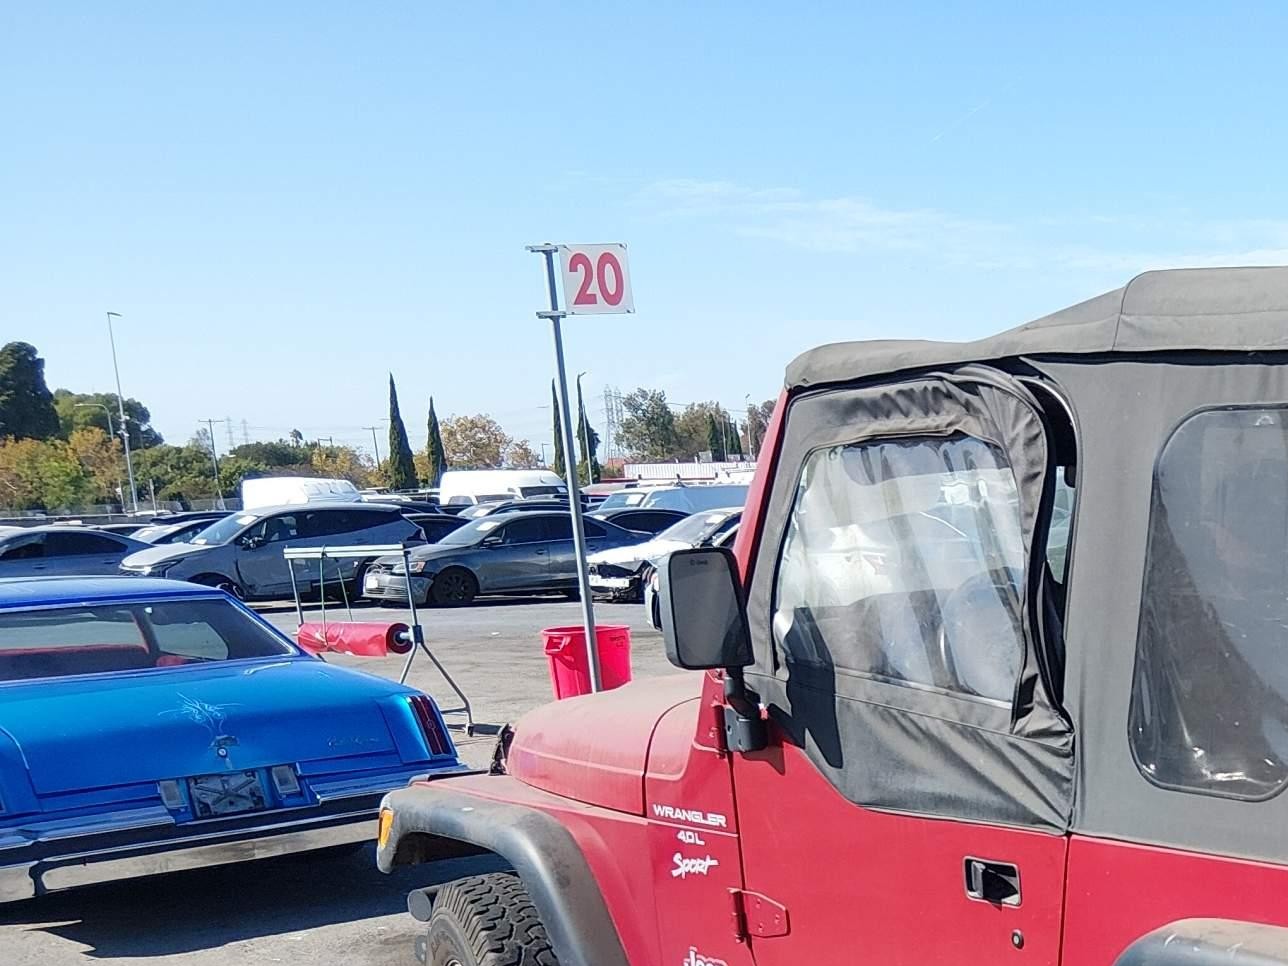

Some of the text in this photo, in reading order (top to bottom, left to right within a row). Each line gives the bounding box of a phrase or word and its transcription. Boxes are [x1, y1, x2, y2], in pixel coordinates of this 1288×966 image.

[568, 252, 625, 306] 20
[652, 804, 727, 828] WRANGLER
[671, 852, 719, 880] Sport
